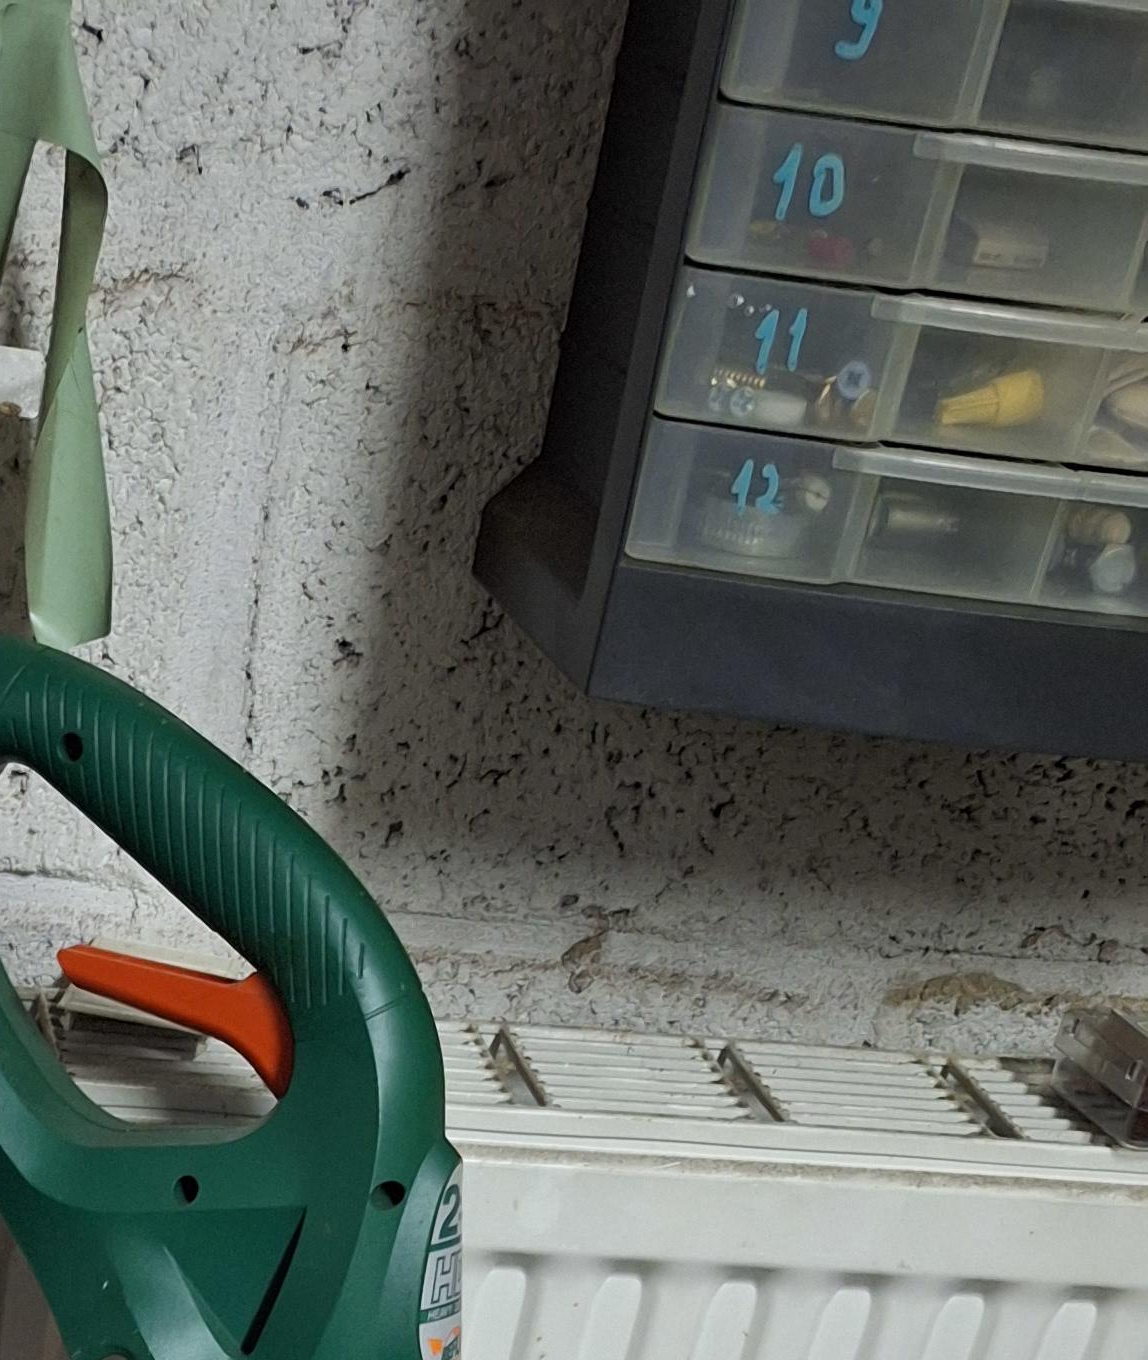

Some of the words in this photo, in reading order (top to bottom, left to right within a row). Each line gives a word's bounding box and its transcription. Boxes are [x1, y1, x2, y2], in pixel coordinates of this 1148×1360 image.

[834, 0, 884, 60] 9
[772, 143, 846, 221] 10
[754, 308, 808, 375] 11
[731, 459, 783, 516] 12
